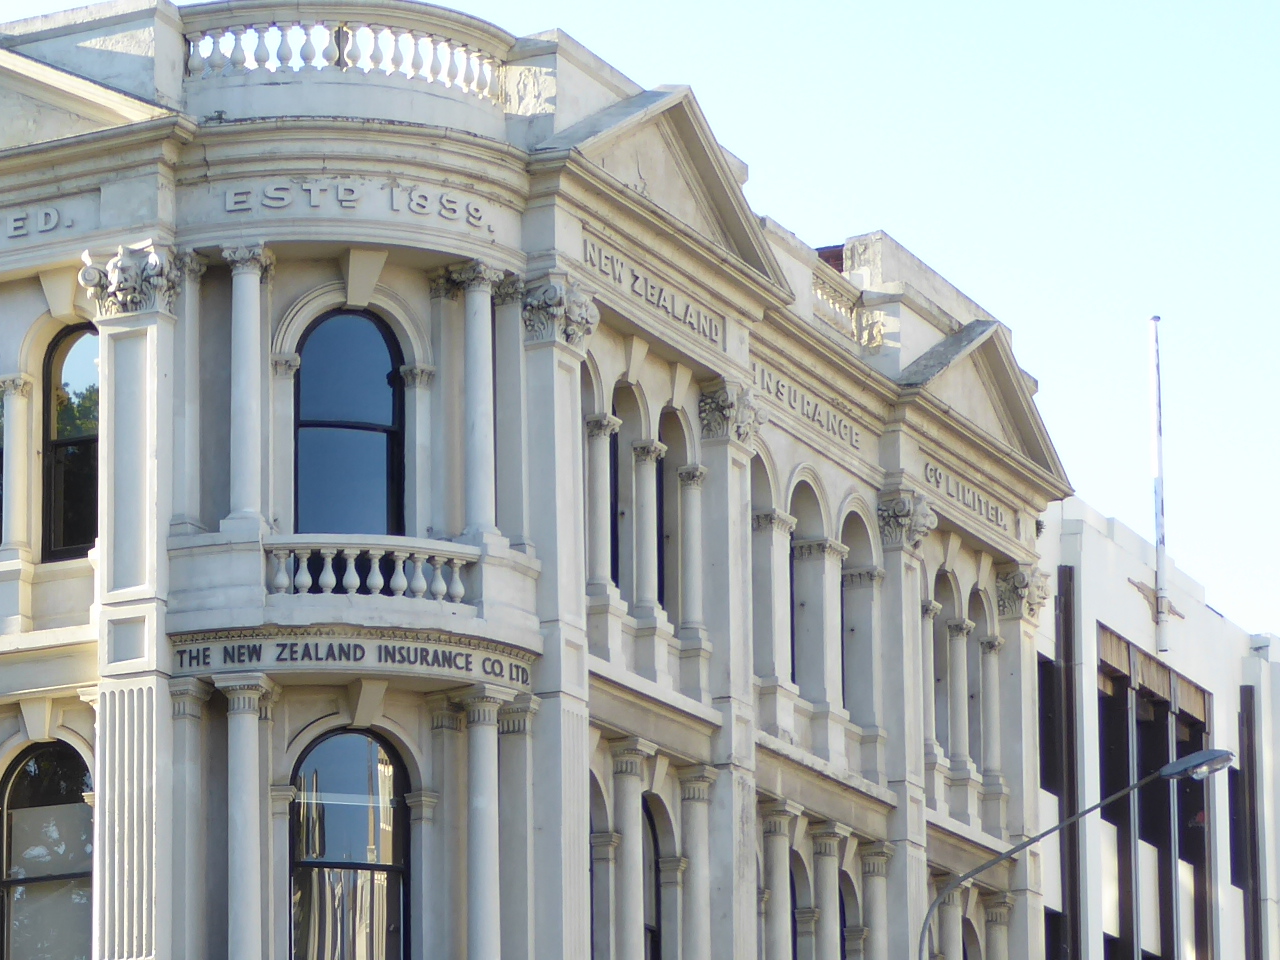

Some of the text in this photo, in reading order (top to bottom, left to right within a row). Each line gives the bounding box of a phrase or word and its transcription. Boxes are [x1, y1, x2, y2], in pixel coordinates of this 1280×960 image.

[583, 238, 720, 344] NEW ZEALAND
[752, 362, 861, 450] INSURANCE
[177, 647, 211, 668] THE
[222, 643, 262, 664] NEW
[275, 642, 365, 662] ZEALAND
[377, 644, 473, 672] INSURANCE
